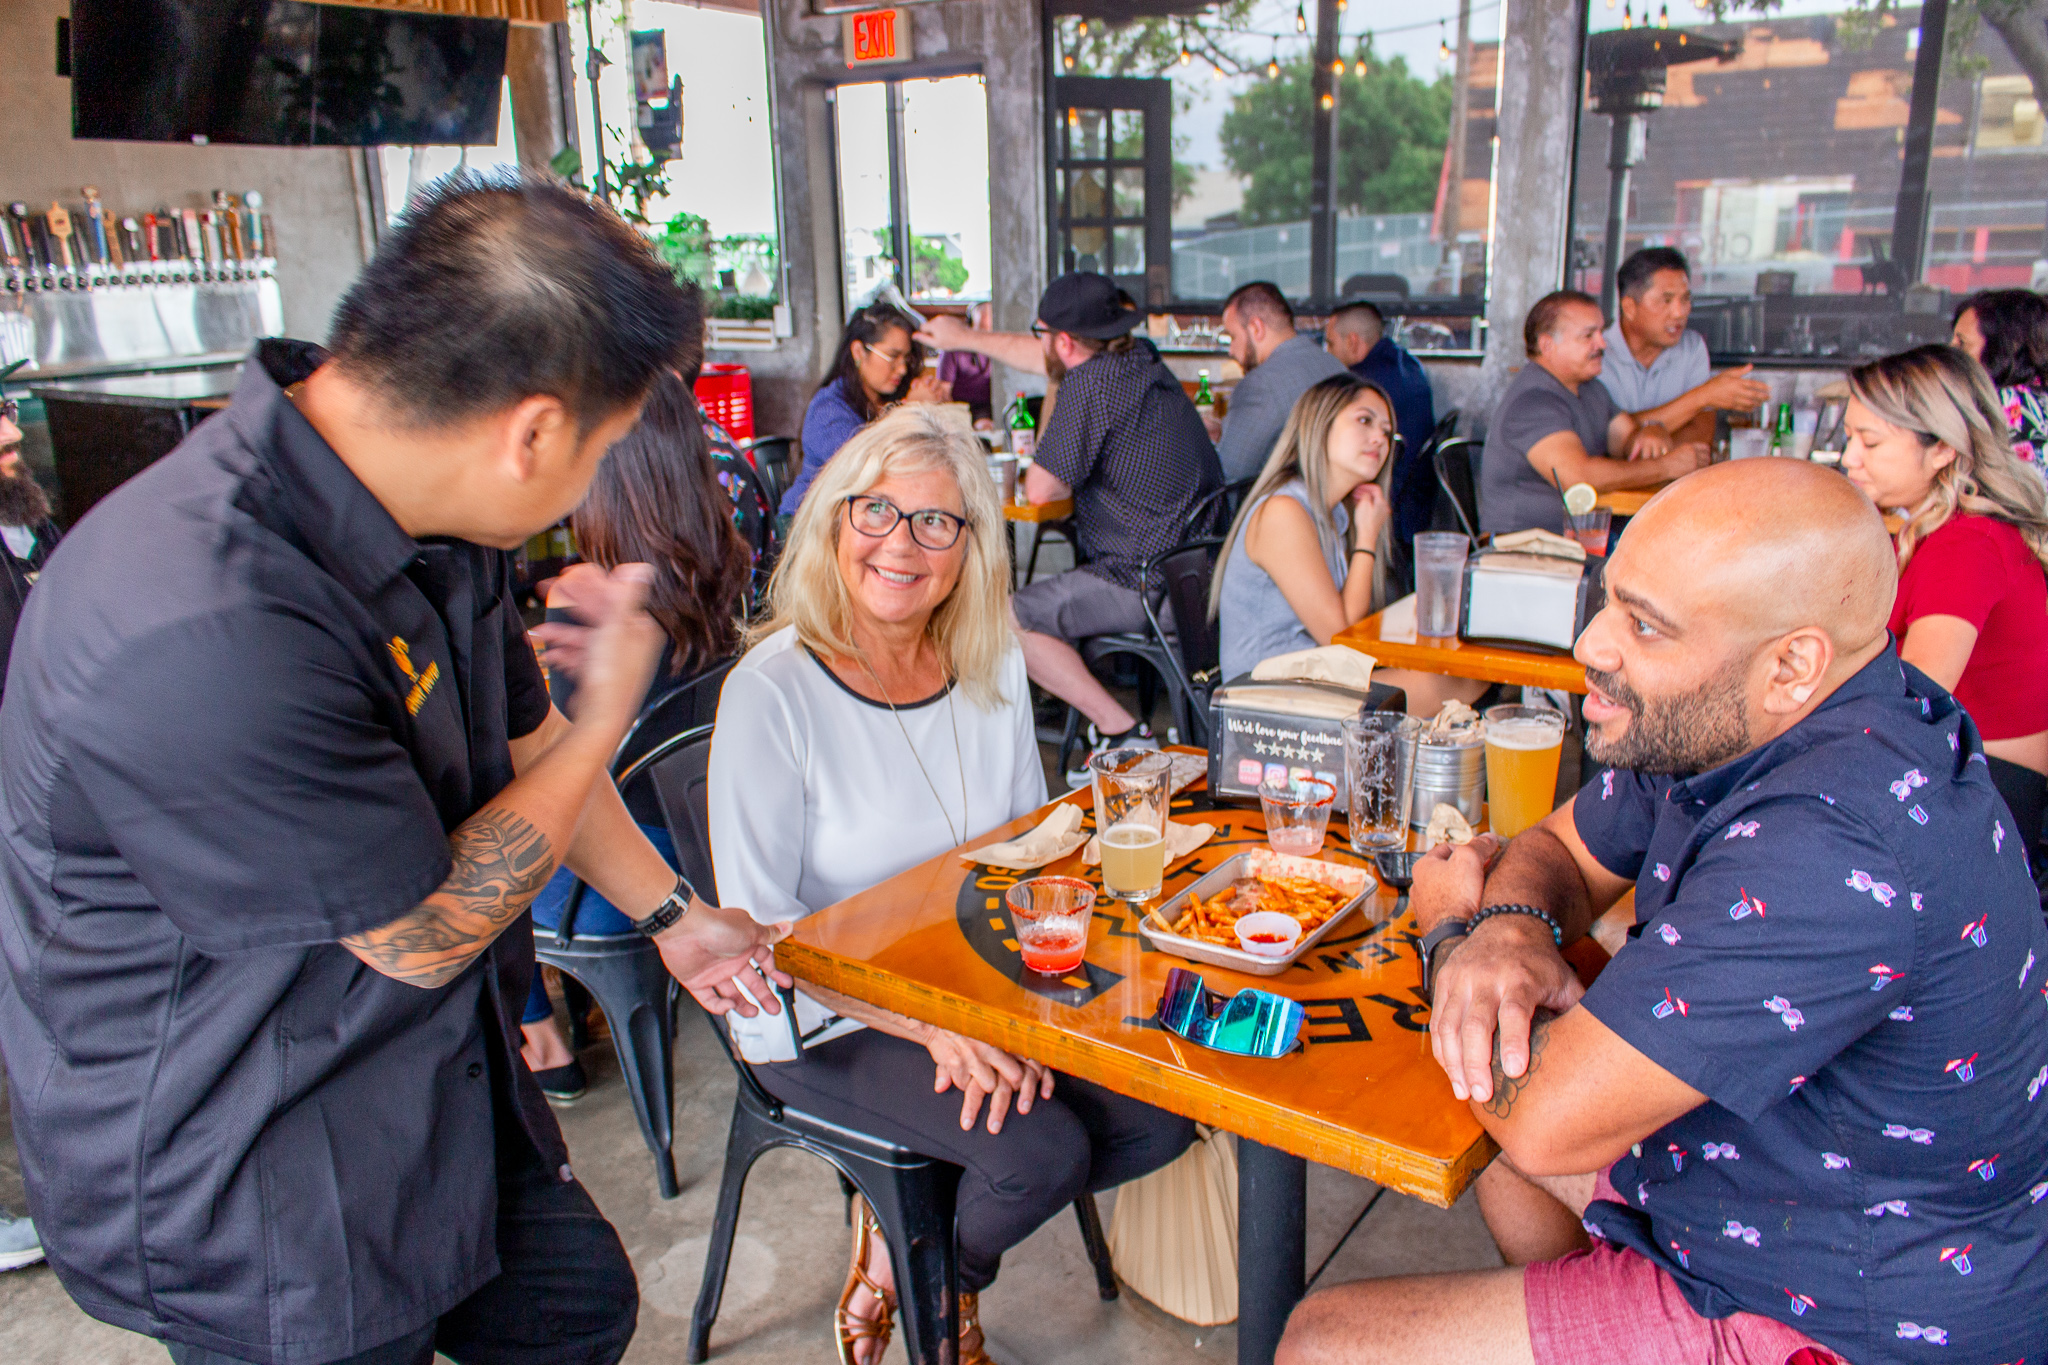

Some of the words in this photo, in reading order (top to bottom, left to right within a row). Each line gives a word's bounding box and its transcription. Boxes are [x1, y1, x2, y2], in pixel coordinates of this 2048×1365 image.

[852, 9, 897, 60] EXIT
[1227, 717, 1254, 735] We'd
[1255, 721, 1276, 738] love
[1276, 728, 1299, 741] your
[1300, 729, 1343, 746] feedbac
